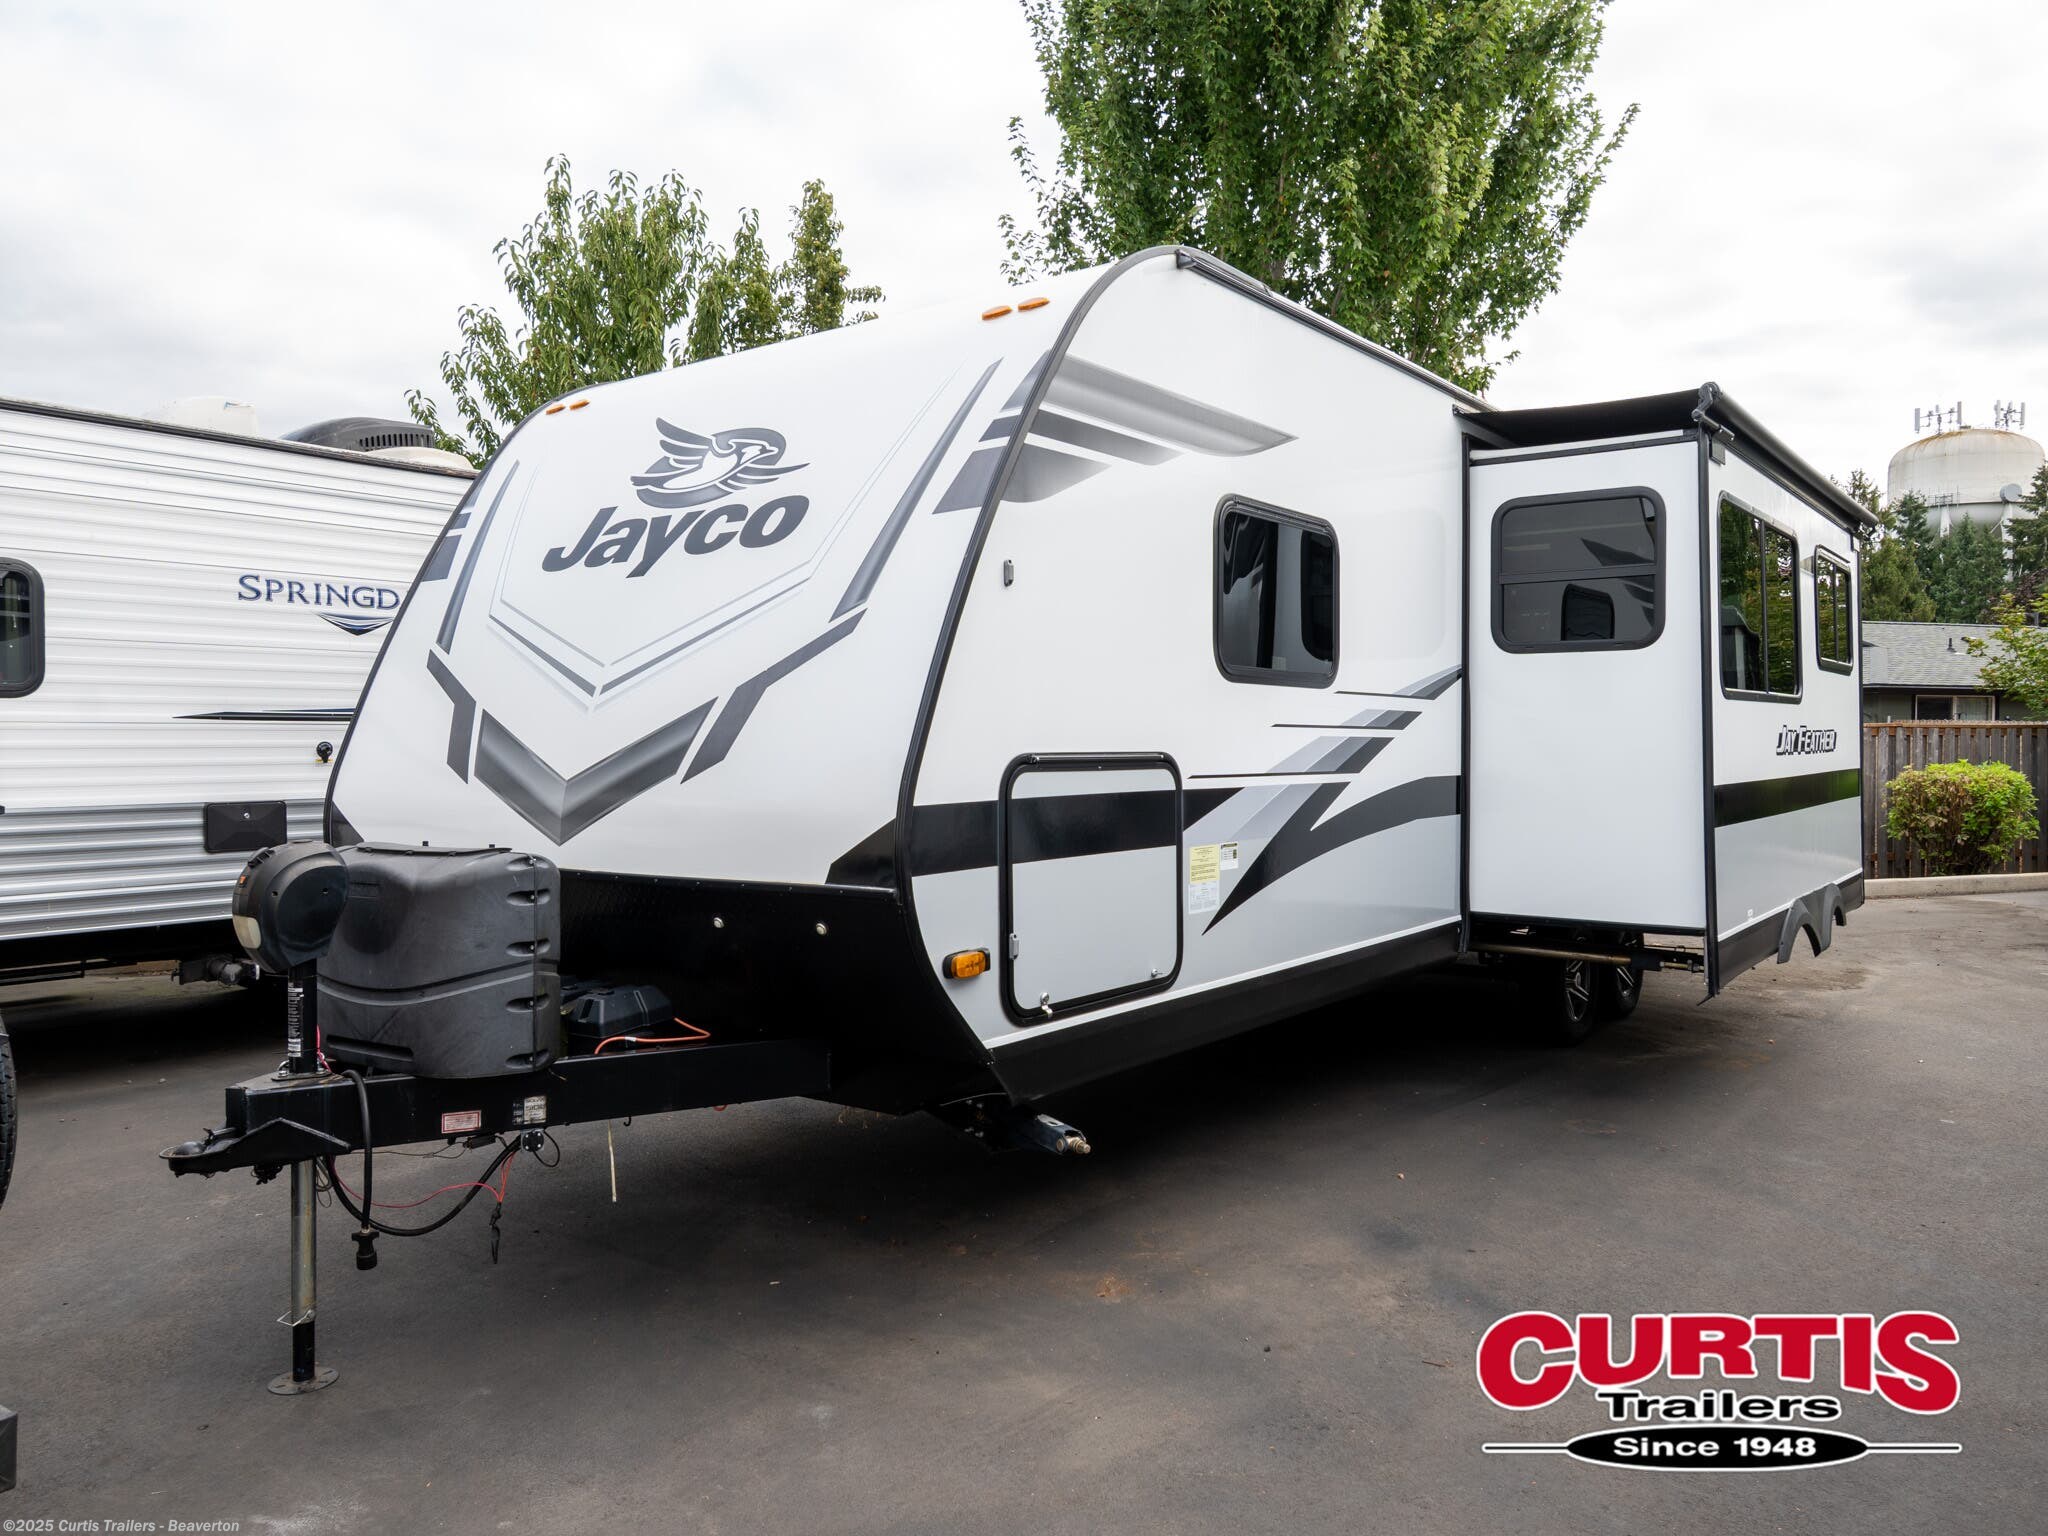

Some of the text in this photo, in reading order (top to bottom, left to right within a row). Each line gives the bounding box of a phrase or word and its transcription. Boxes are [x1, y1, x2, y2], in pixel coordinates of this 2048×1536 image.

[541, 495, 811, 579] Jayco
[1776, 725, 1837, 756] JAY FEATHER
